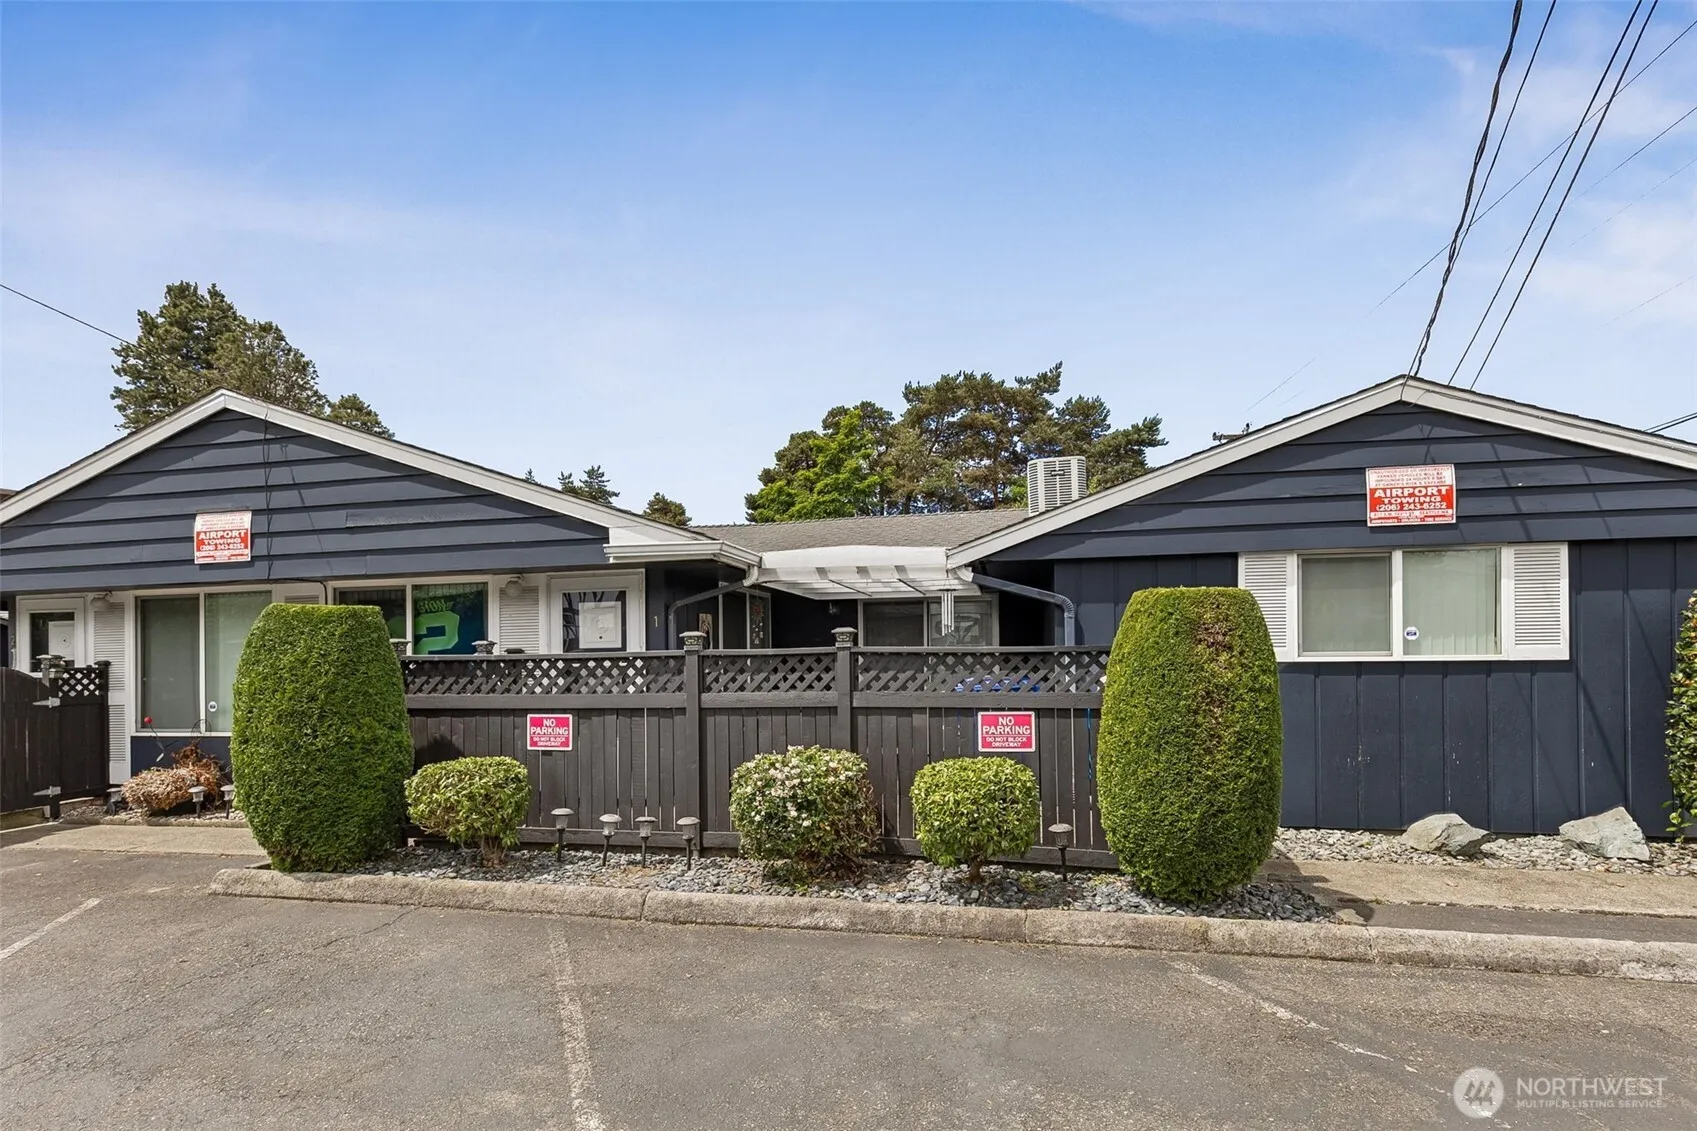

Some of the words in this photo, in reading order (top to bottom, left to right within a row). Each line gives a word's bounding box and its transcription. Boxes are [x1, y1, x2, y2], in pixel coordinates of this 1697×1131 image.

[1374, 486, 1450, 497] AIRPORT
[1382, 496, 1442, 504] TOWING
[1403, 502, 1447, 510] 243-6252
[199, 530, 247, 540] AIRPORT
[653, 615, 658, 628] 1
[543, 718, 556, 727] NO
[998, 716, 1015, 726] NO
[530, 727, 569, 735] PARKING
[982, 725, 1031, 735] PARKING
